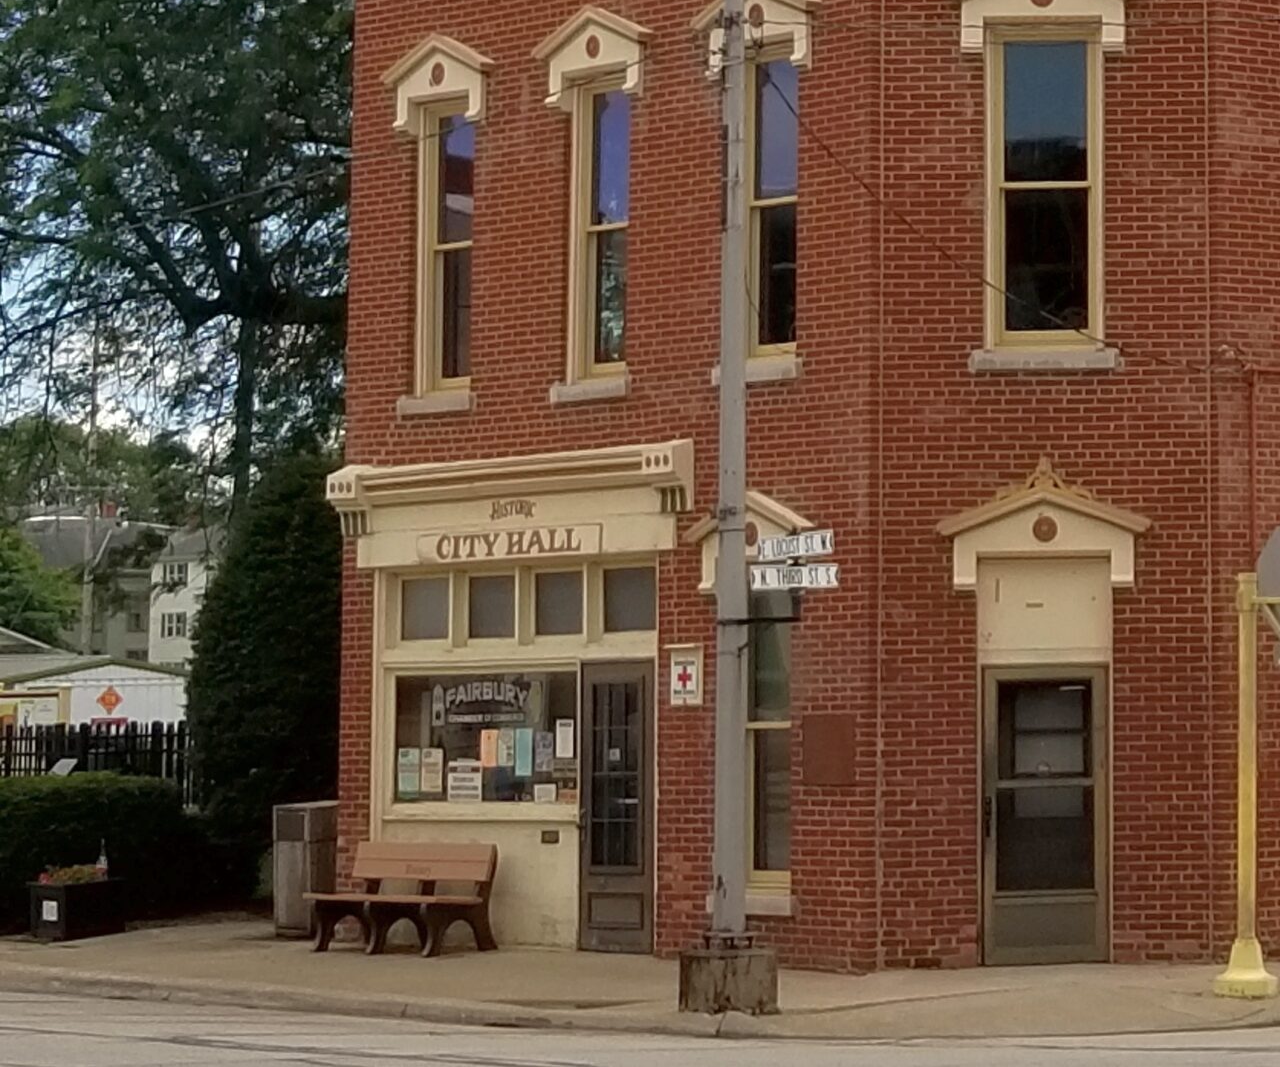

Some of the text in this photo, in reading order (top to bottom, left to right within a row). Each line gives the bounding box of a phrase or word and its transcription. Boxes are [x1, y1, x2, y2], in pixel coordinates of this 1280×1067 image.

[436, 528, 582, 560] CITY HALL
[772, 536, 800, 557] LOCUST
[776, 567, 804, 586] THIRD
[446, 681, 528, 710] FAIRBURY
